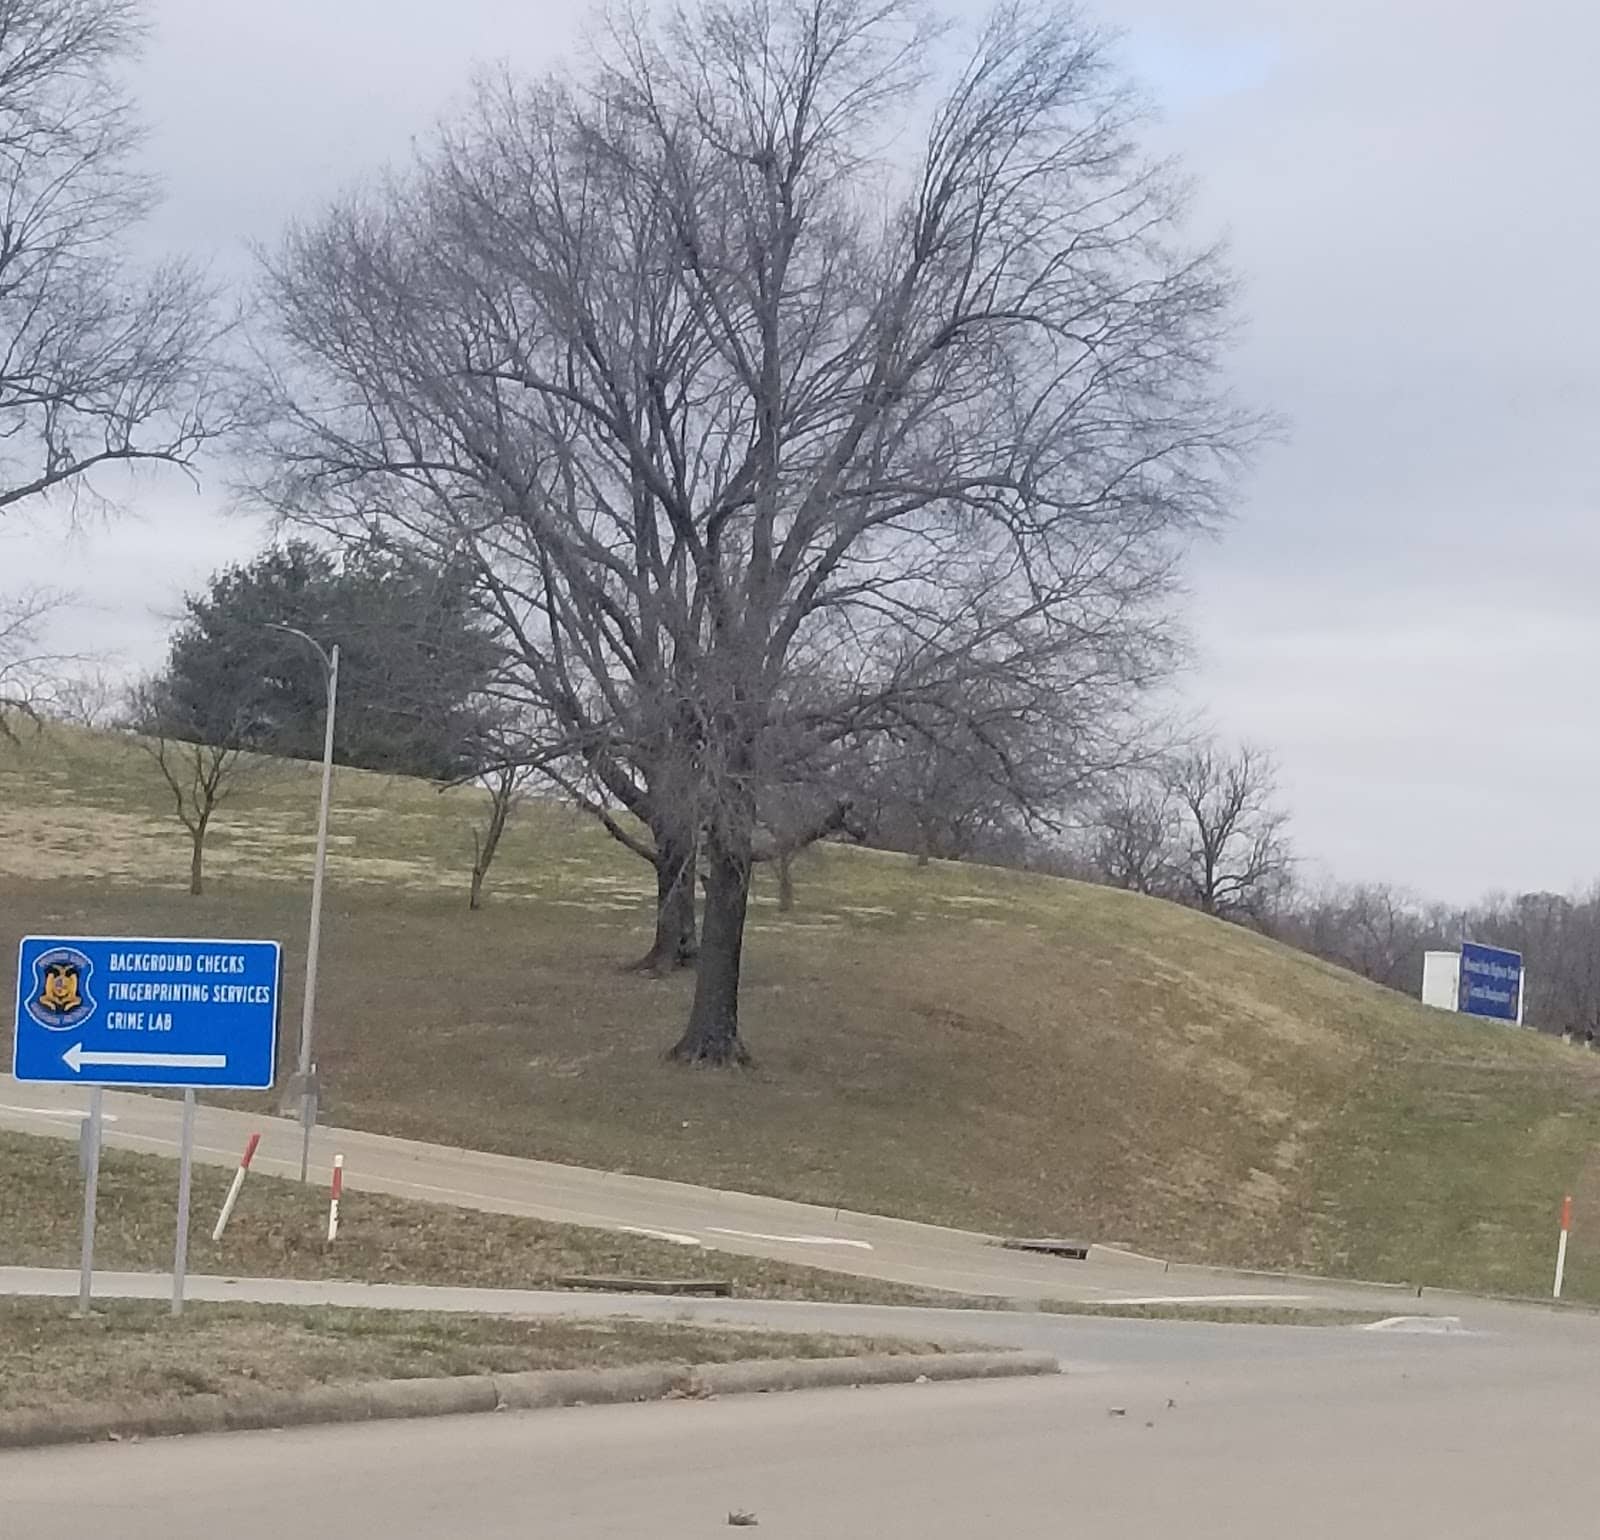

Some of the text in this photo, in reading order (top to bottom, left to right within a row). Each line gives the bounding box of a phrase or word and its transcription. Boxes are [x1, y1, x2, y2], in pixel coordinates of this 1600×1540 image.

[110, 953, 245, 973] BACKGROUND CHECKS
[108, 984, 270, 1004] FINGERPRINTING SERVICES
[107, 1012, 144, 1030] CRIME
[148, 1013, 172, 1031] LAB
